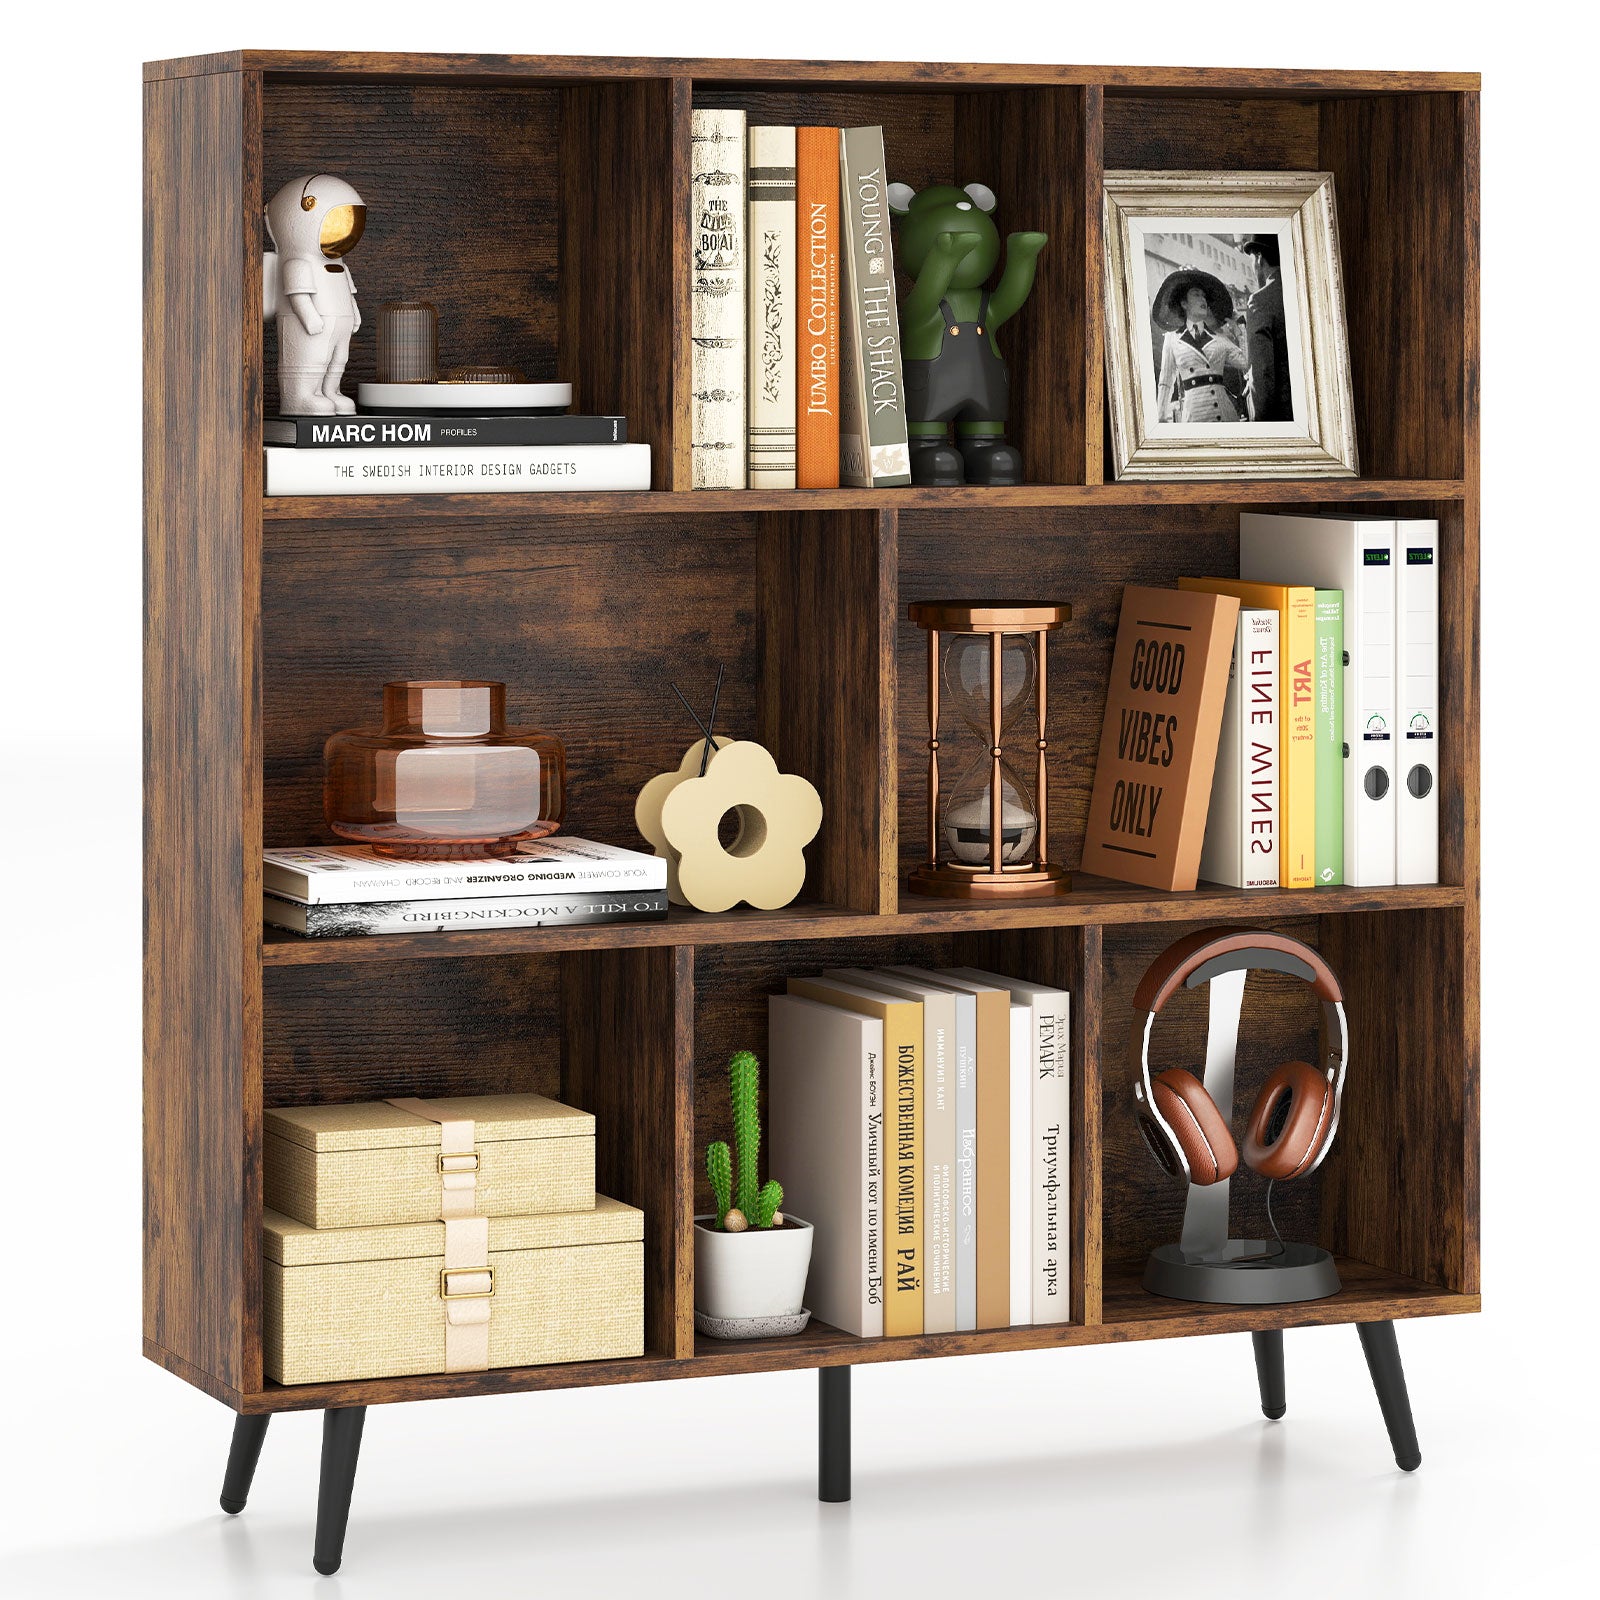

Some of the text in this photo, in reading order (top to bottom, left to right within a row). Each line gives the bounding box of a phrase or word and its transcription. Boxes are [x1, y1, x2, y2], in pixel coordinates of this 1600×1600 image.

[709, 200, 728, 211] THE
[857, 168, 884, 254] YOUNG
[702, 234, 733, 251] BOAT
[808, 203, 832, 415] JUMBO COLLECTION
[863, 280, 898, 415] THE SHACK
[312, 423, 431, 442] MARC HOM
[440, 428, 477, 437] PROFILES
[334, 463, 577, 478] THE SWEDISH INTERIOR DESIGN GADGETS
[1130, 638, 1185, 695] GOOD
[1118, 708, 1178, 768] VIBES
[1109, 779, 1163, 838] ONLY
[405, 876, 441, 886] RECORD
[445, 875, 463, 885] AND
[466, 873, 525, 884] ORGANIZER
[527, 872, 576, 882] WEDDING
[623, 868, 648, 878] YOUR
[402, 901, 663, 923] TO KILL A MOCKINGBIRD
[936, 1028, 945, 1111] ИММАНУИЛ КАНТ
[959, 1046, 967, 1089] ПУШКИН
[1039, 1014, 1055, 1080] РЕМАРК
[1056, 1014, 1066, 1078] Эрих Мария
[869, 1080, 877, 1107] БОУЭН
[896, 1044, 915, 1235] БОЖЕСТВЕННАЯ КОМЕДИЯ
[958, 1128, 975, 1217] Избранное
[868, 1112, 883, 1304] Уличный кот по имени Боб
[942, 1164, 950, 1293] ФИЛОСОФСКО-ИСТОРИЧЕСКИЕ
[1043, 1123, 1060, 1297] Триумфальная арка
[897, 1248, 920, 1292] РАЙ
[933, 1243, 941, 1295] СОЧИНЕНИЯ
